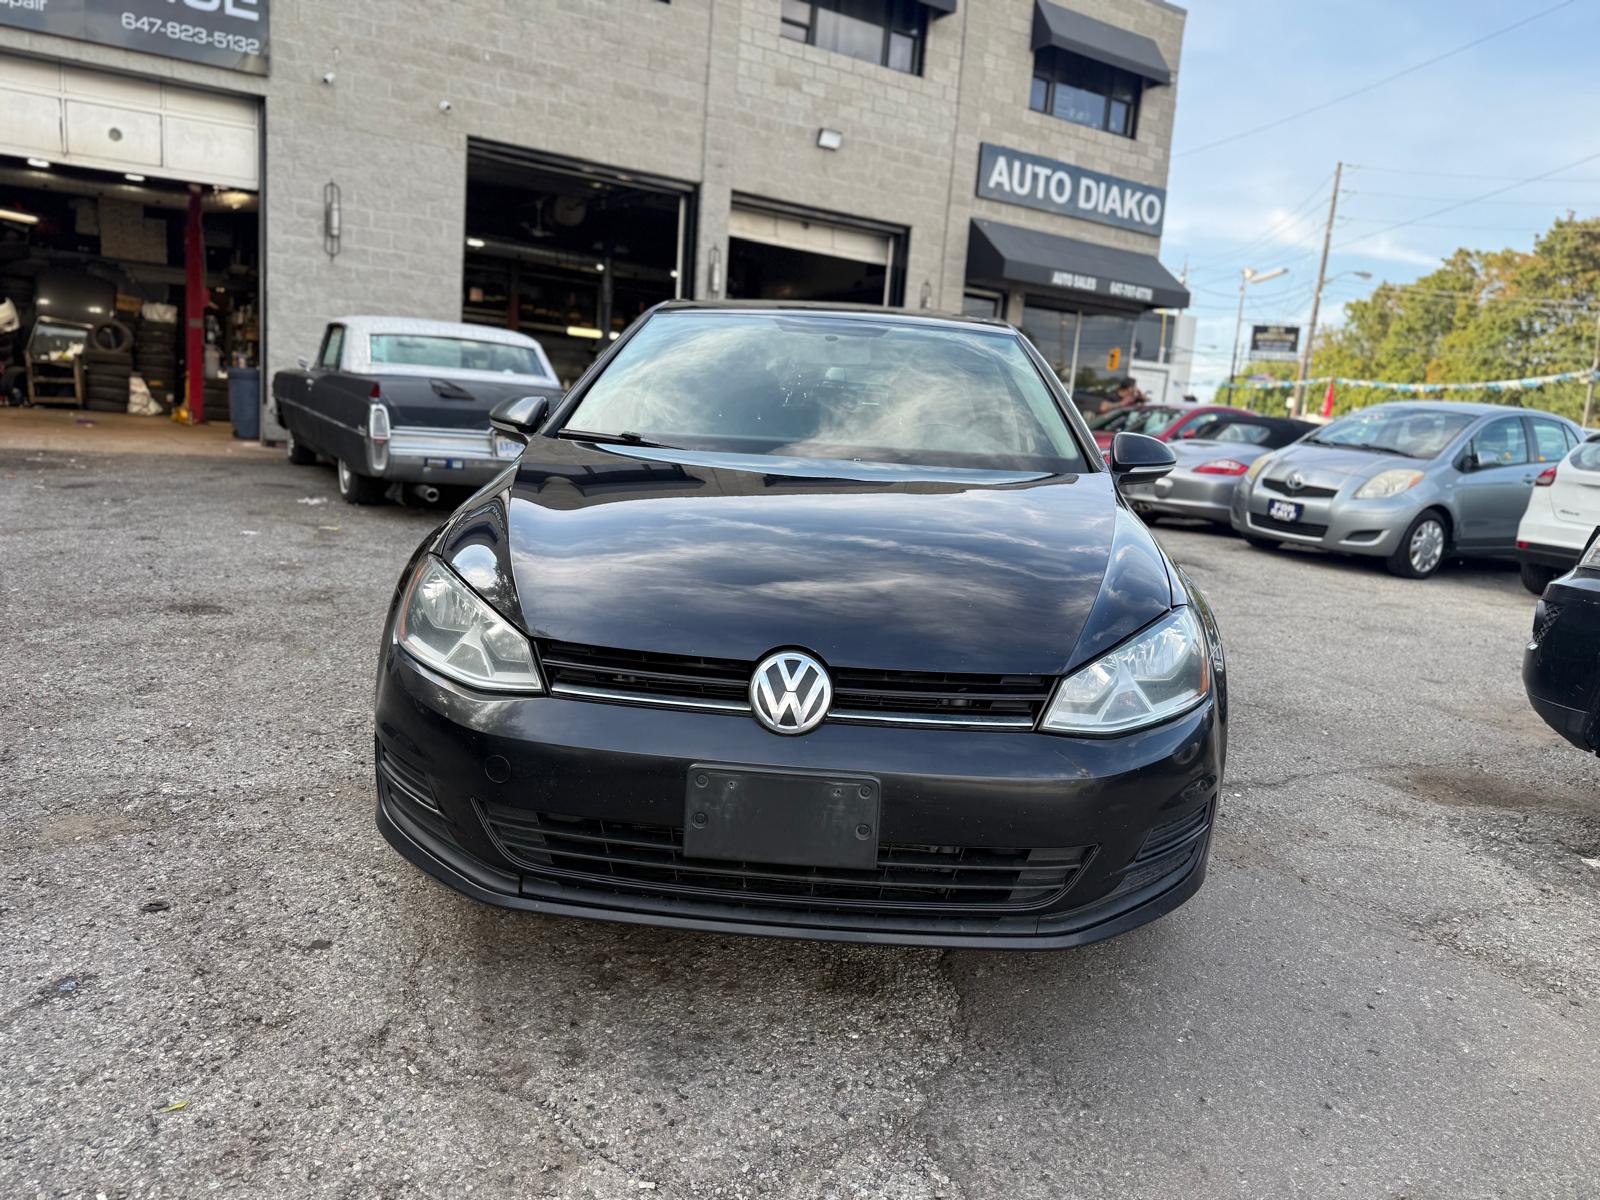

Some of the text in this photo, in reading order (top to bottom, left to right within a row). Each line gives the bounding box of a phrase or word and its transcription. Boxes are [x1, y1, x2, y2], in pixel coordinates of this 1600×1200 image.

[121, 12, 260, 55] 647-823-5132
[988, 156, 1162, 225] AUTO DIAKO
[1052, 271, 1073, 287] AUTO
[1074, 274, 1097, 291] SALES
[752, 653, 831, 732] VW
